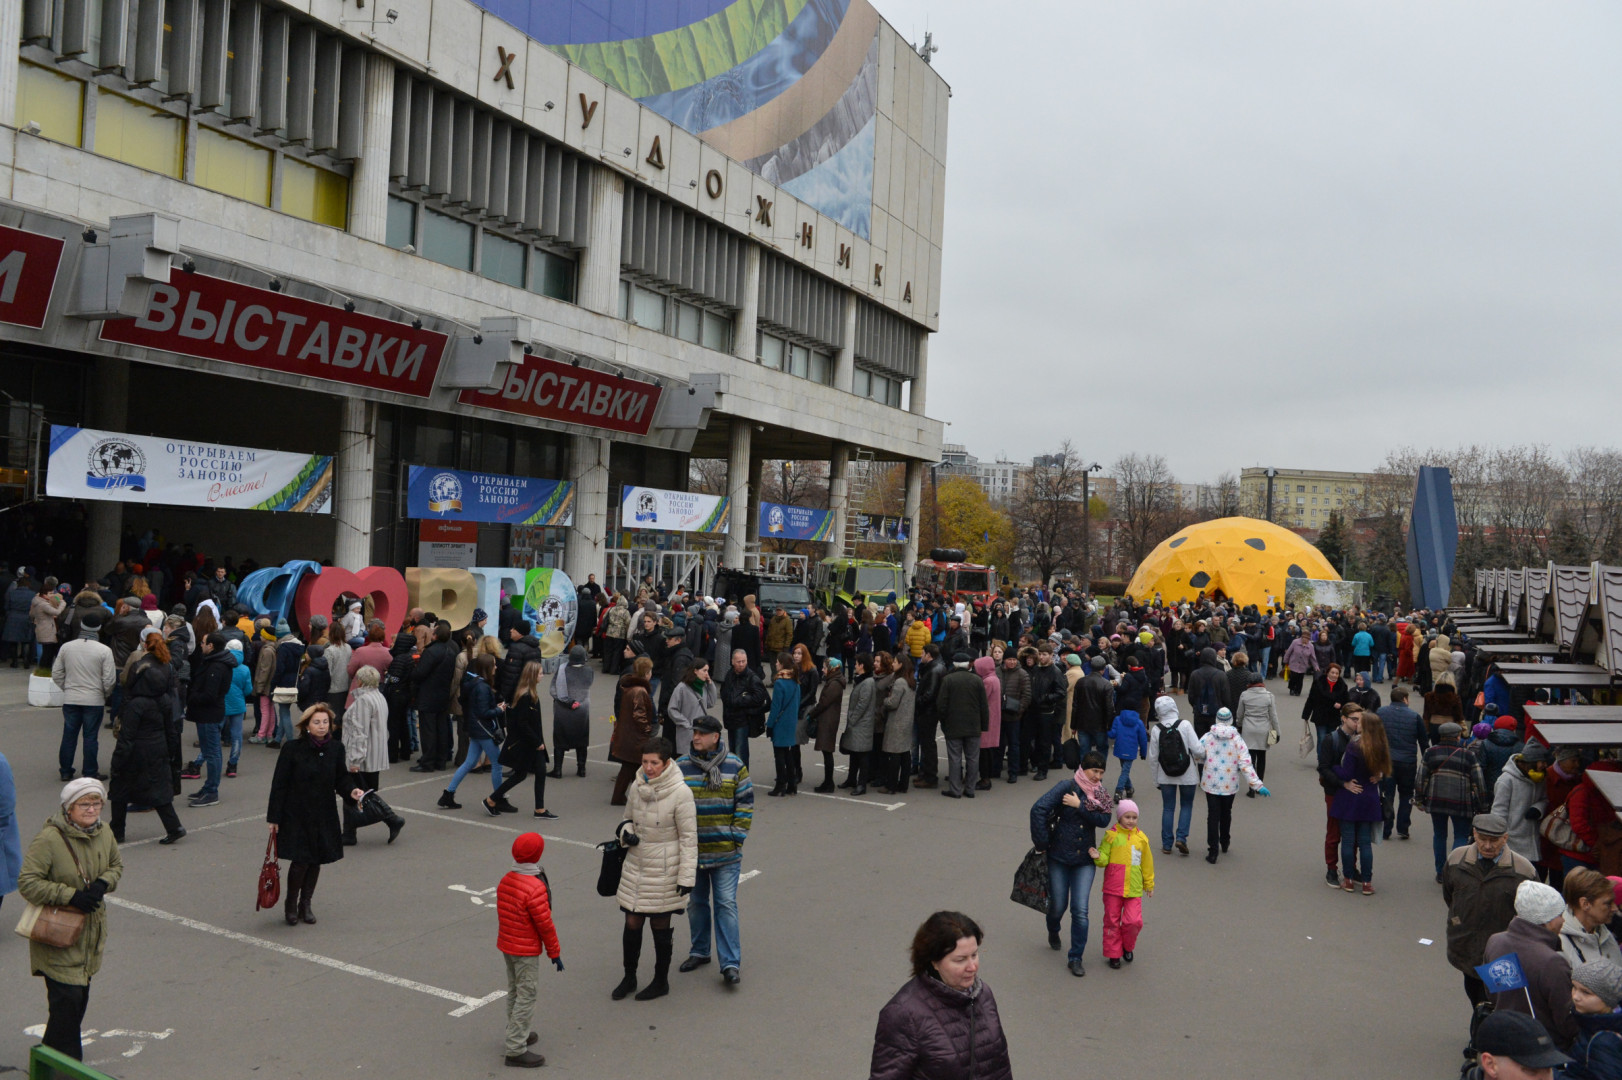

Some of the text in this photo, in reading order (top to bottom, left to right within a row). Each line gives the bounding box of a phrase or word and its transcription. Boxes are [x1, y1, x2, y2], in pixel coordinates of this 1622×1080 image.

[493, 45, 912, 304] ХУДОЖНИКА
[133, 283, 428, 382] ВЫСТАВКИ
[477, 364, 651, 424] ЫСТАВКИ
[166, 442, 256, 462] ОТКРЫВАЕМ
[180, 456, 242, 472] РОССИЮ
[178, 468, 242, 483] ЗАНОВО!
[472, 475, 528, 488] ОТКРЫВАЕМ
[207, 472, 268, 503] Вместе!
[480, 485, 519, 496] РОССИЮ
[478, 494, 519, 505] ЗАНОВО!
[663, 492, 699, 501] ОТКРЫВАЕМ
